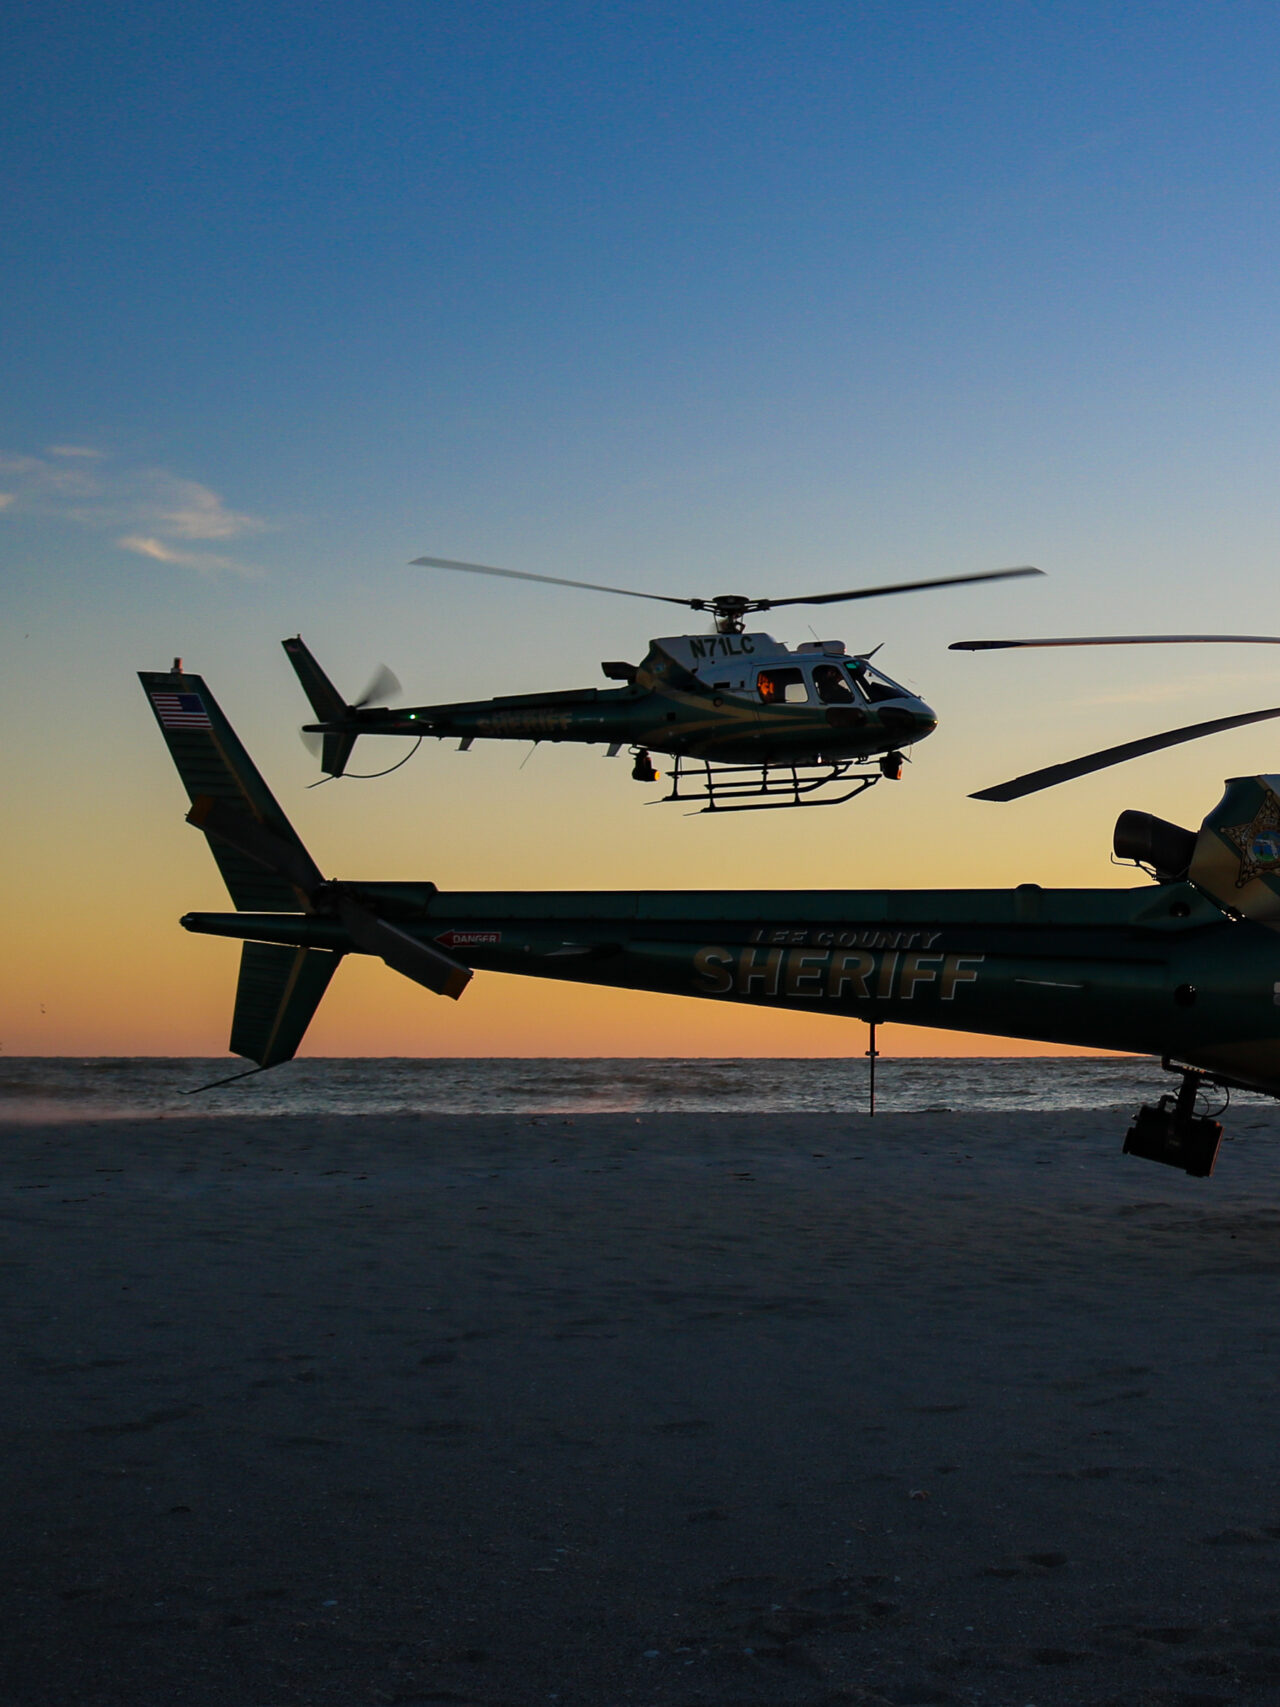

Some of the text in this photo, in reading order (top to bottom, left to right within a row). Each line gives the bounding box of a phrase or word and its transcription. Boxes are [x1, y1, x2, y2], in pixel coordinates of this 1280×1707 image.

[690, 635, 755, 658] N71LC
[453, 935, 497, 943] DANGER
[749, 928, 944, 949] LEE COUNTY
[691, 946, 986, 1001] SHERIFF
